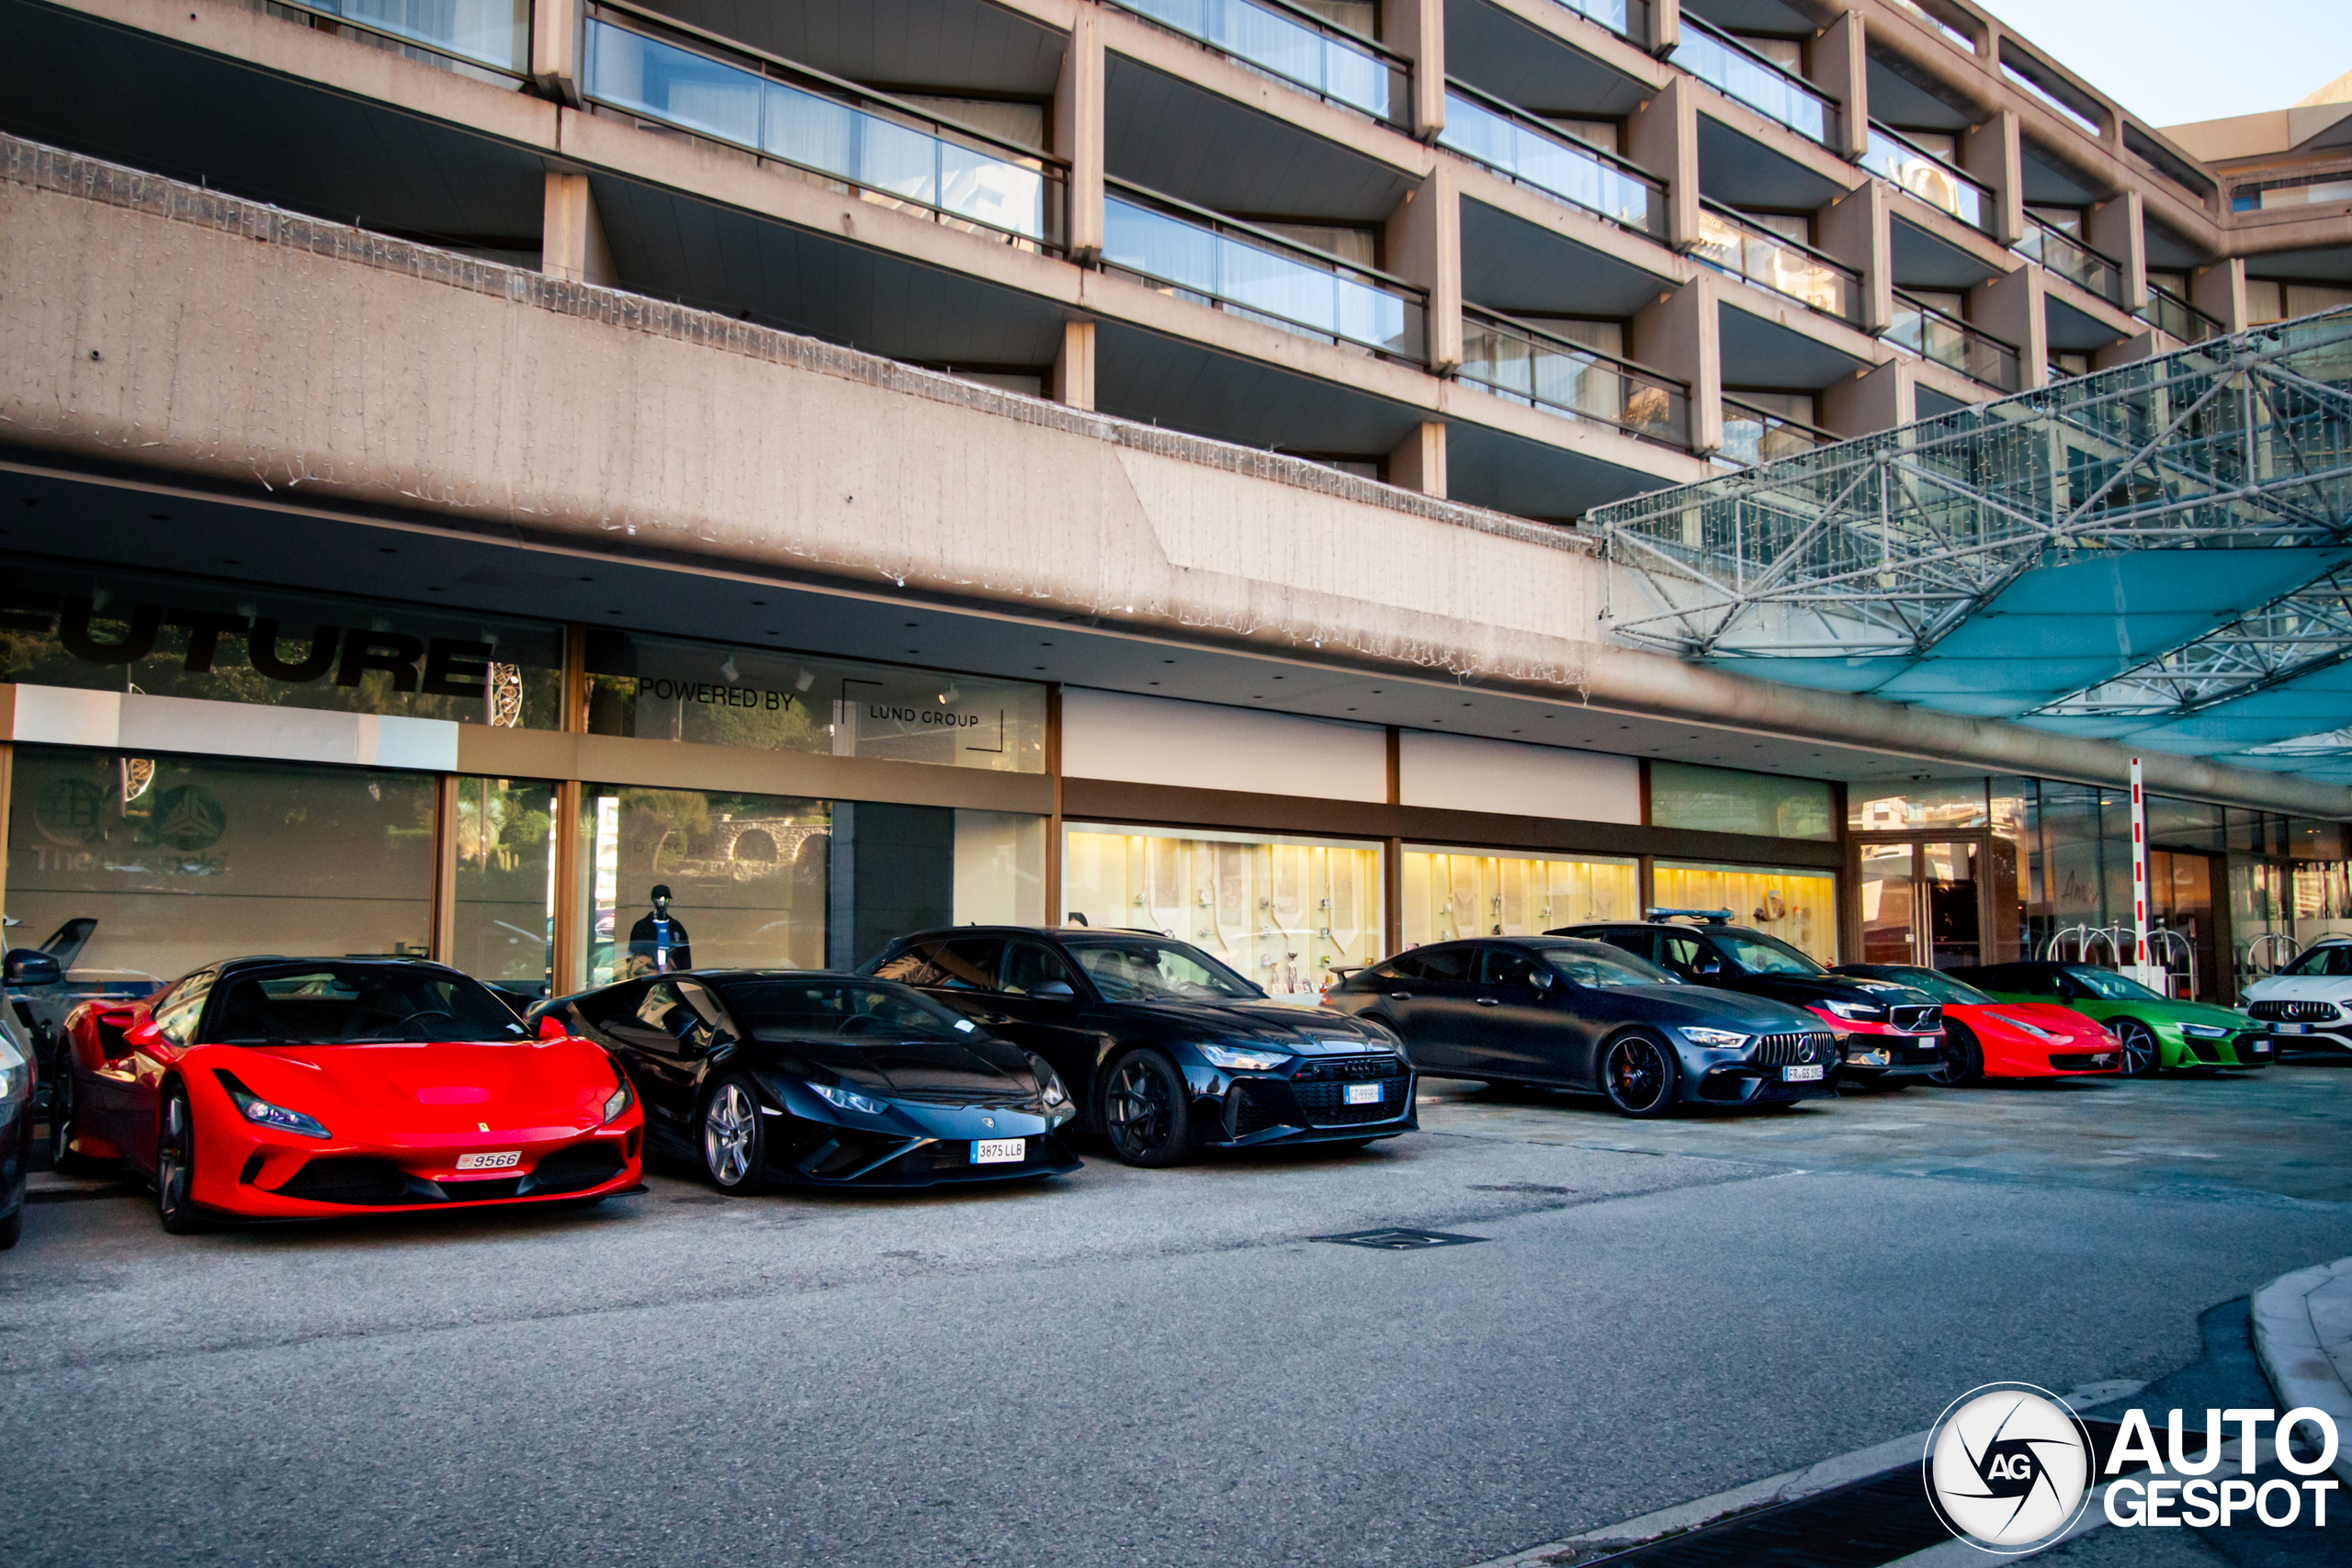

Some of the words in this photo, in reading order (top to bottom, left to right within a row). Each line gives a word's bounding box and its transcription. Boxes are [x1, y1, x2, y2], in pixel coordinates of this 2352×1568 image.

[639, 677, 758, 708] POWERED
[766, 691, 795, 712] BY
[870, 705, 916, 722] LUND
[922, 711, 978, 728] GROUP
[979, 1145, 1003, 1157] 3875
[1005, 1143, 1023, 1156] LLB
[473, 1154, 517, 1168] 9566
